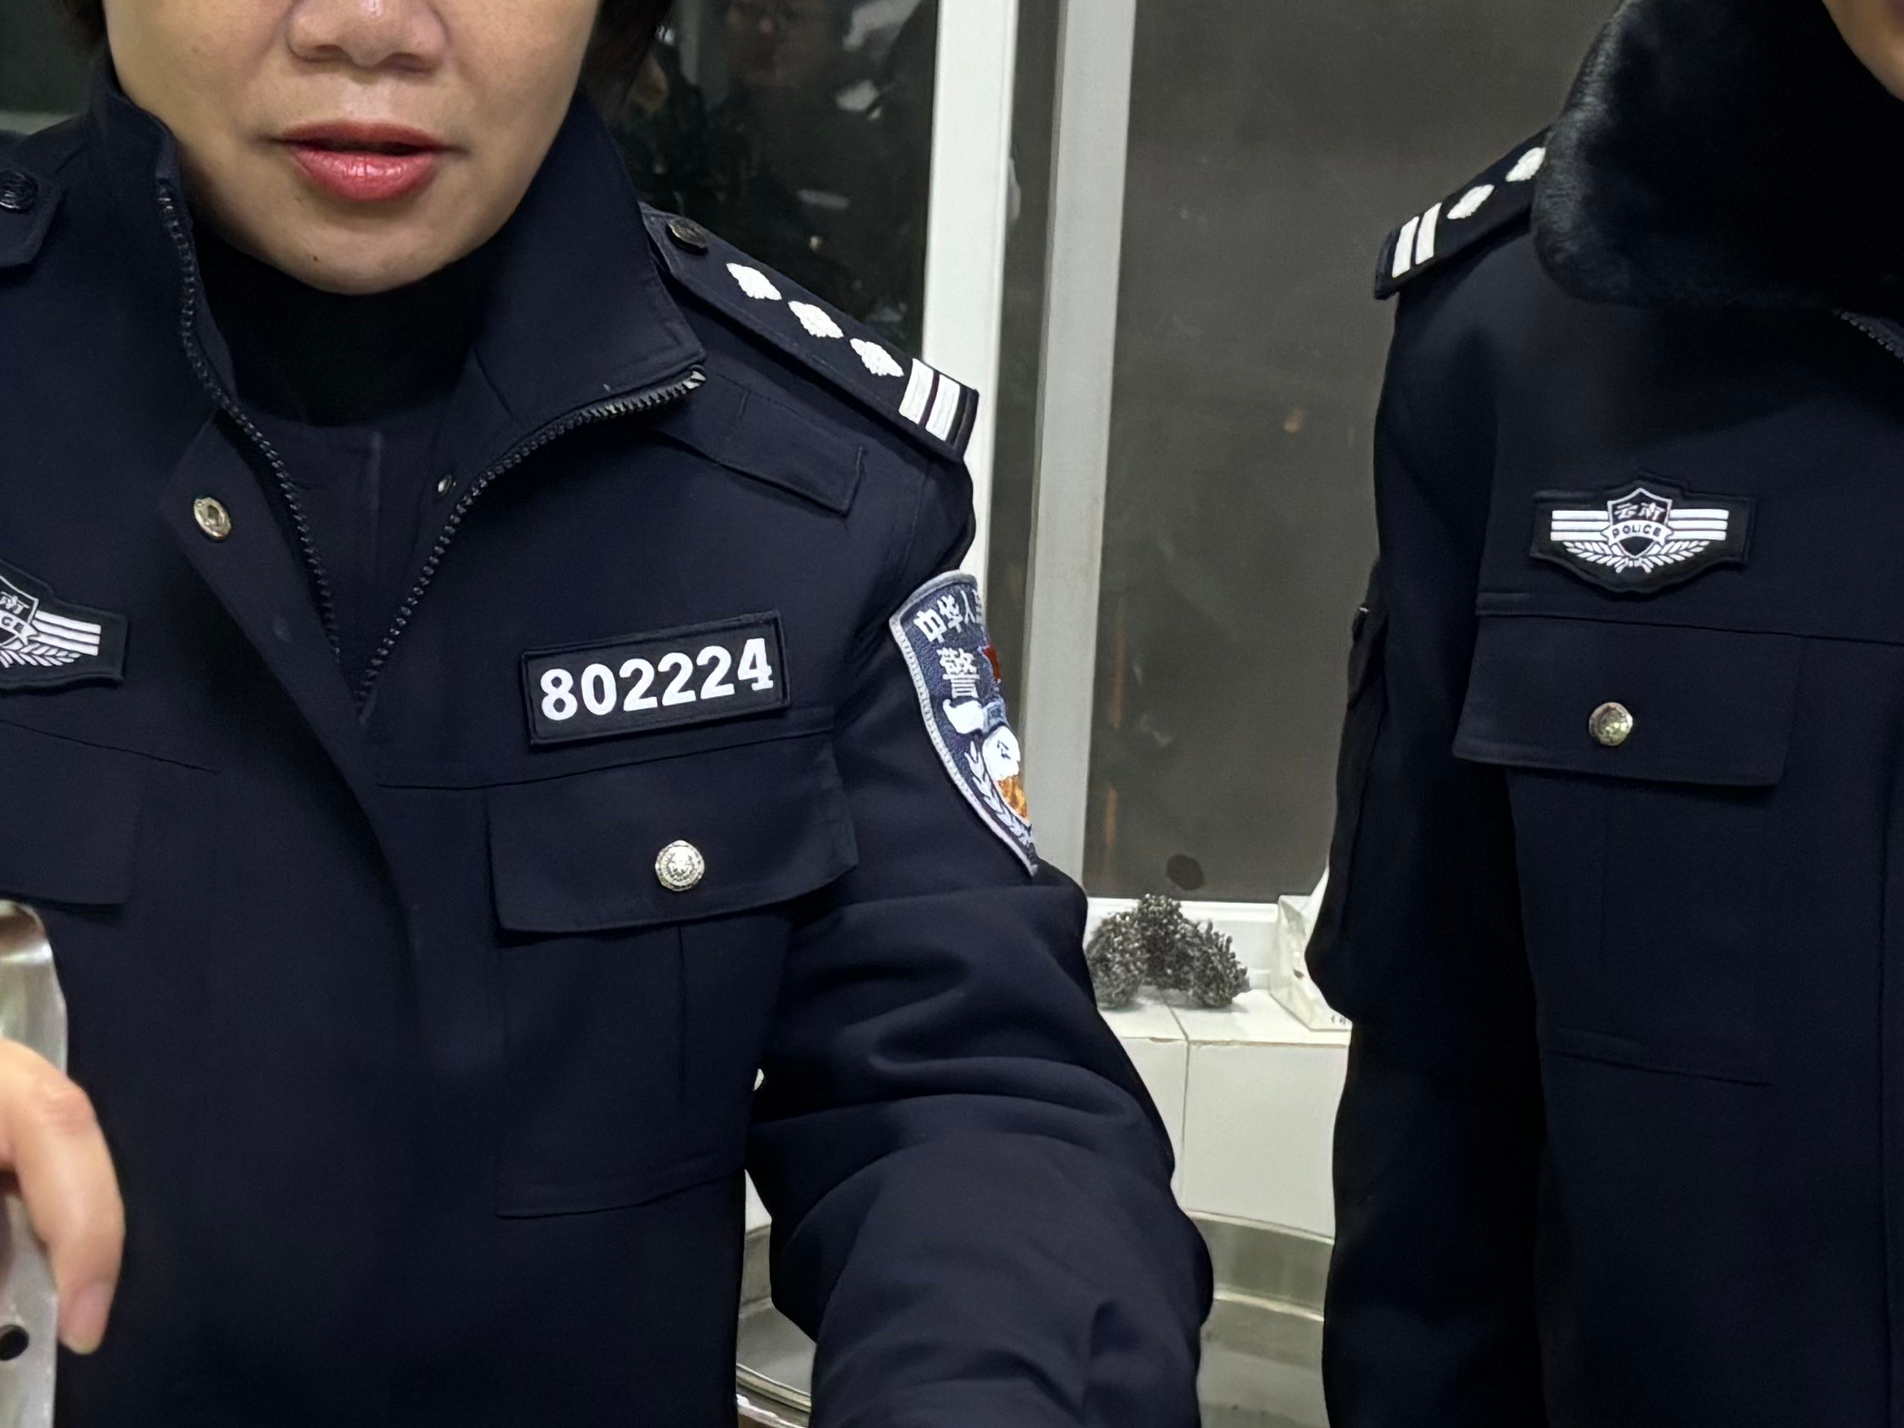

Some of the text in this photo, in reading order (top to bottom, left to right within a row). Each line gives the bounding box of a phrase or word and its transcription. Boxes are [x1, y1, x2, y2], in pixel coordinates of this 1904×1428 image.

[1612, 524, 1662, 538] POLICE
[540, 638, 774, 721] 802224
[936, 647, 980, 698] 警
